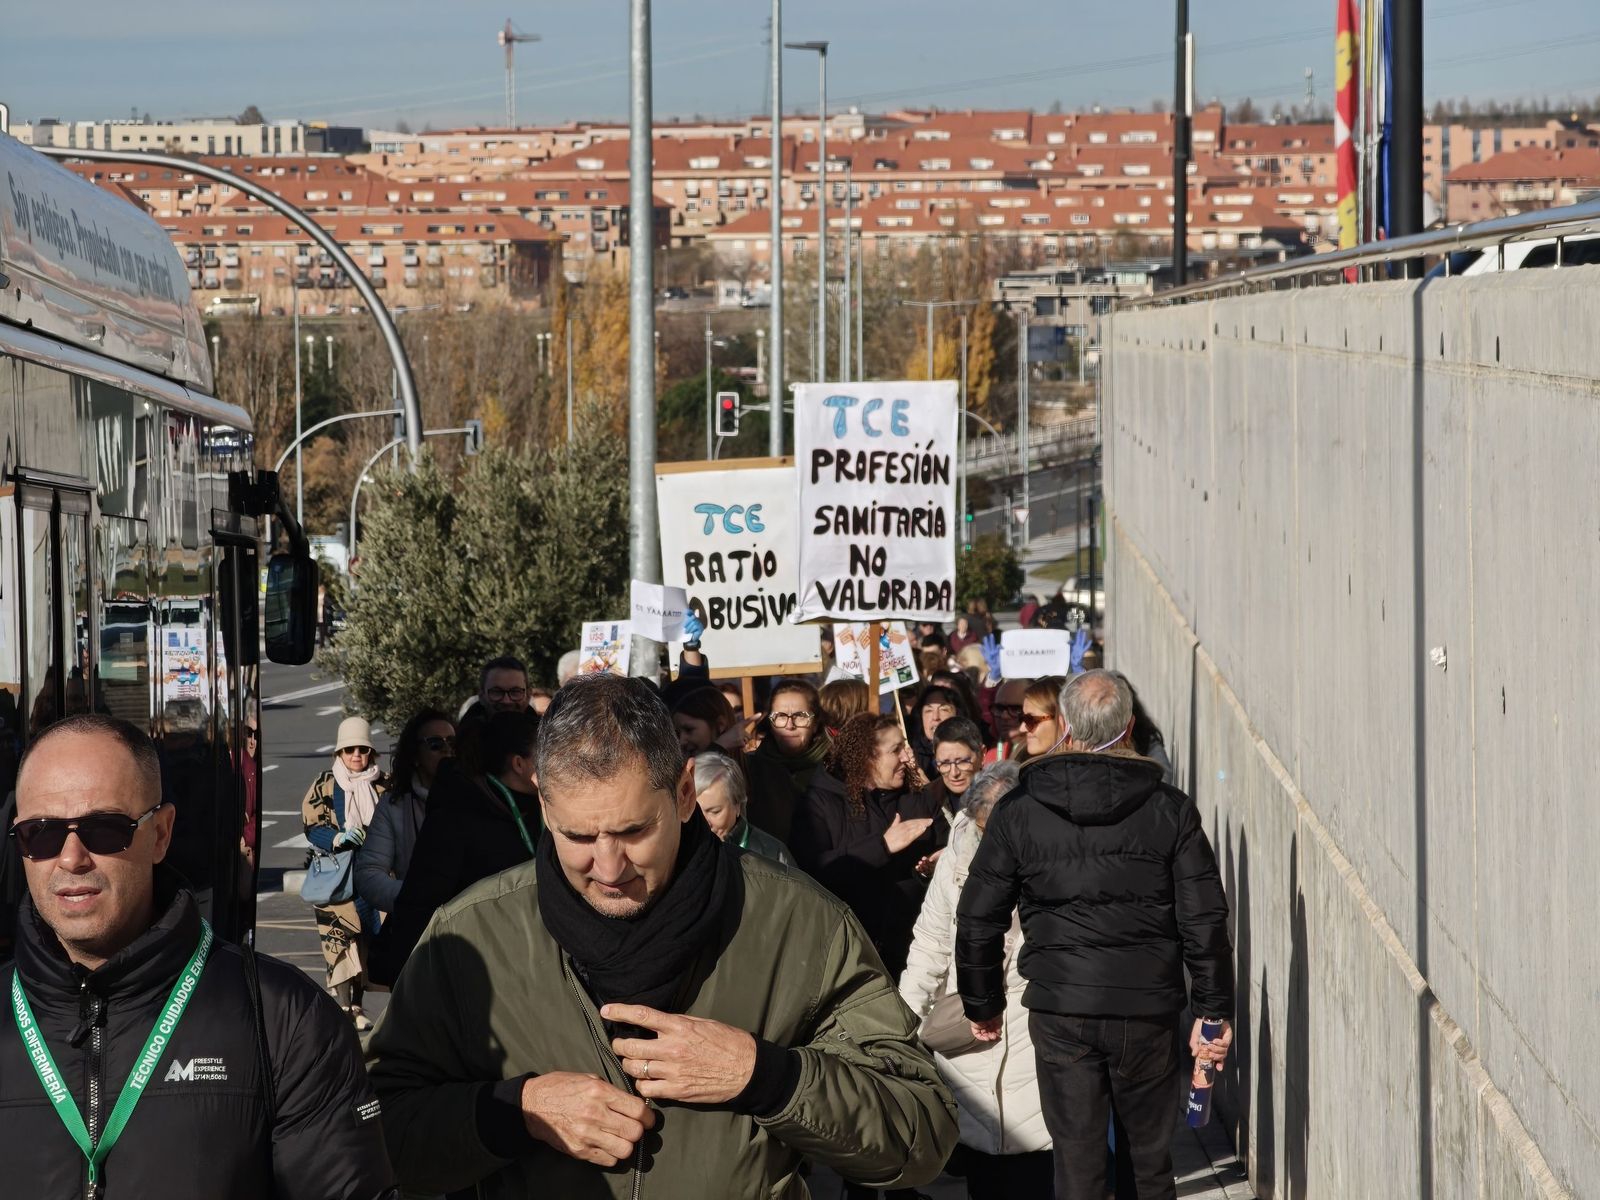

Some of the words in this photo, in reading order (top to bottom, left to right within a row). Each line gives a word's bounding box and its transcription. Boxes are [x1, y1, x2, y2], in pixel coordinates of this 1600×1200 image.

[8, 171, 31, 244] Soy
[823, 395, 910, 439] TCE
[811, 439, 950, 485] PROFESIÓN
[694, 503, 765, 535] TCE
[813, 500, 946, 538] SANITARIA
[684, 543, 777, 586] RATIO
[850, 544, 887, 577] NO
[815, 578, 952, 612] VALORADA
[129, 1034, 166, 1091] TÉCNICO
[159, 974, 196, 1035] CUIDADOS
[24, 1026, 67, 1104] ENFERMERÍA
